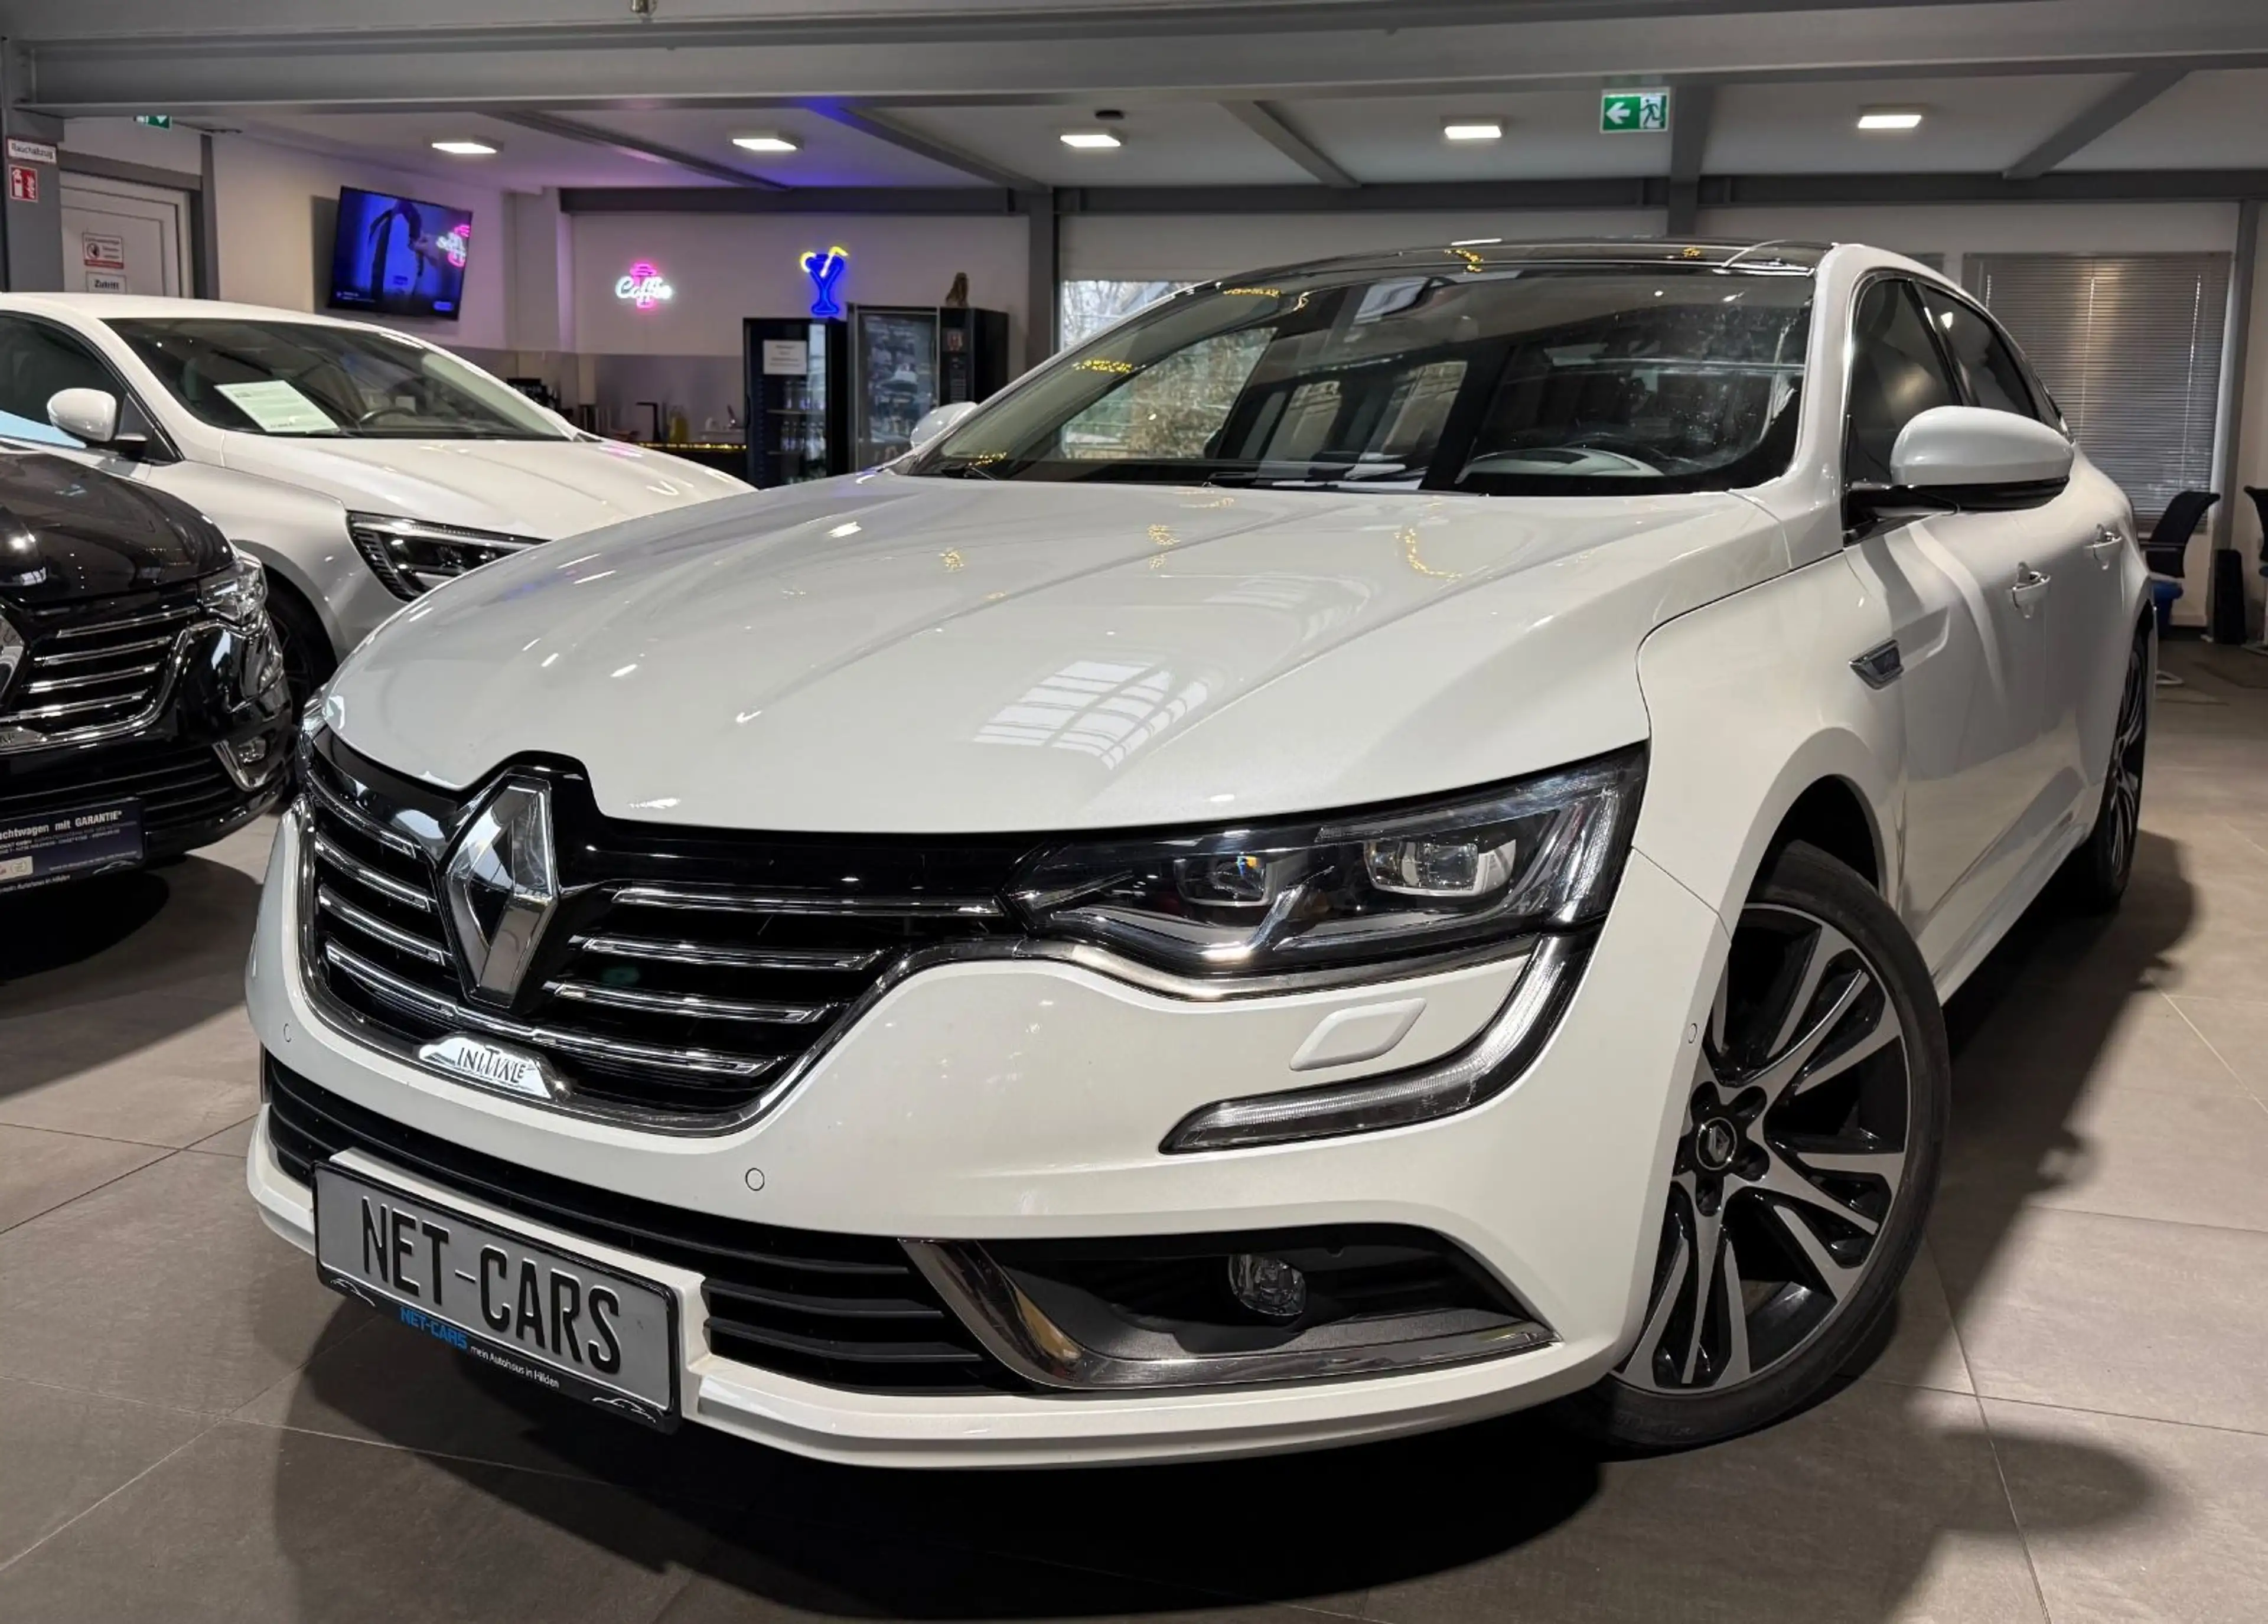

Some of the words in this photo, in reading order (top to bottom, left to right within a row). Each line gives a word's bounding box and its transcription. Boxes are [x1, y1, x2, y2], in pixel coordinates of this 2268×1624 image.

[55, 820, 71, 831] mit
[457, 1047, 526, 1084] INITIALE
[361, 1196, 620, 1374] NET-CARS
[400, 1306, 468, 1350] NET-CARS
[471, 1346, 488, 1360] mein
[489, 1353, 525, 1375] Autohaus
[525, 1365, 533, 1378] in
